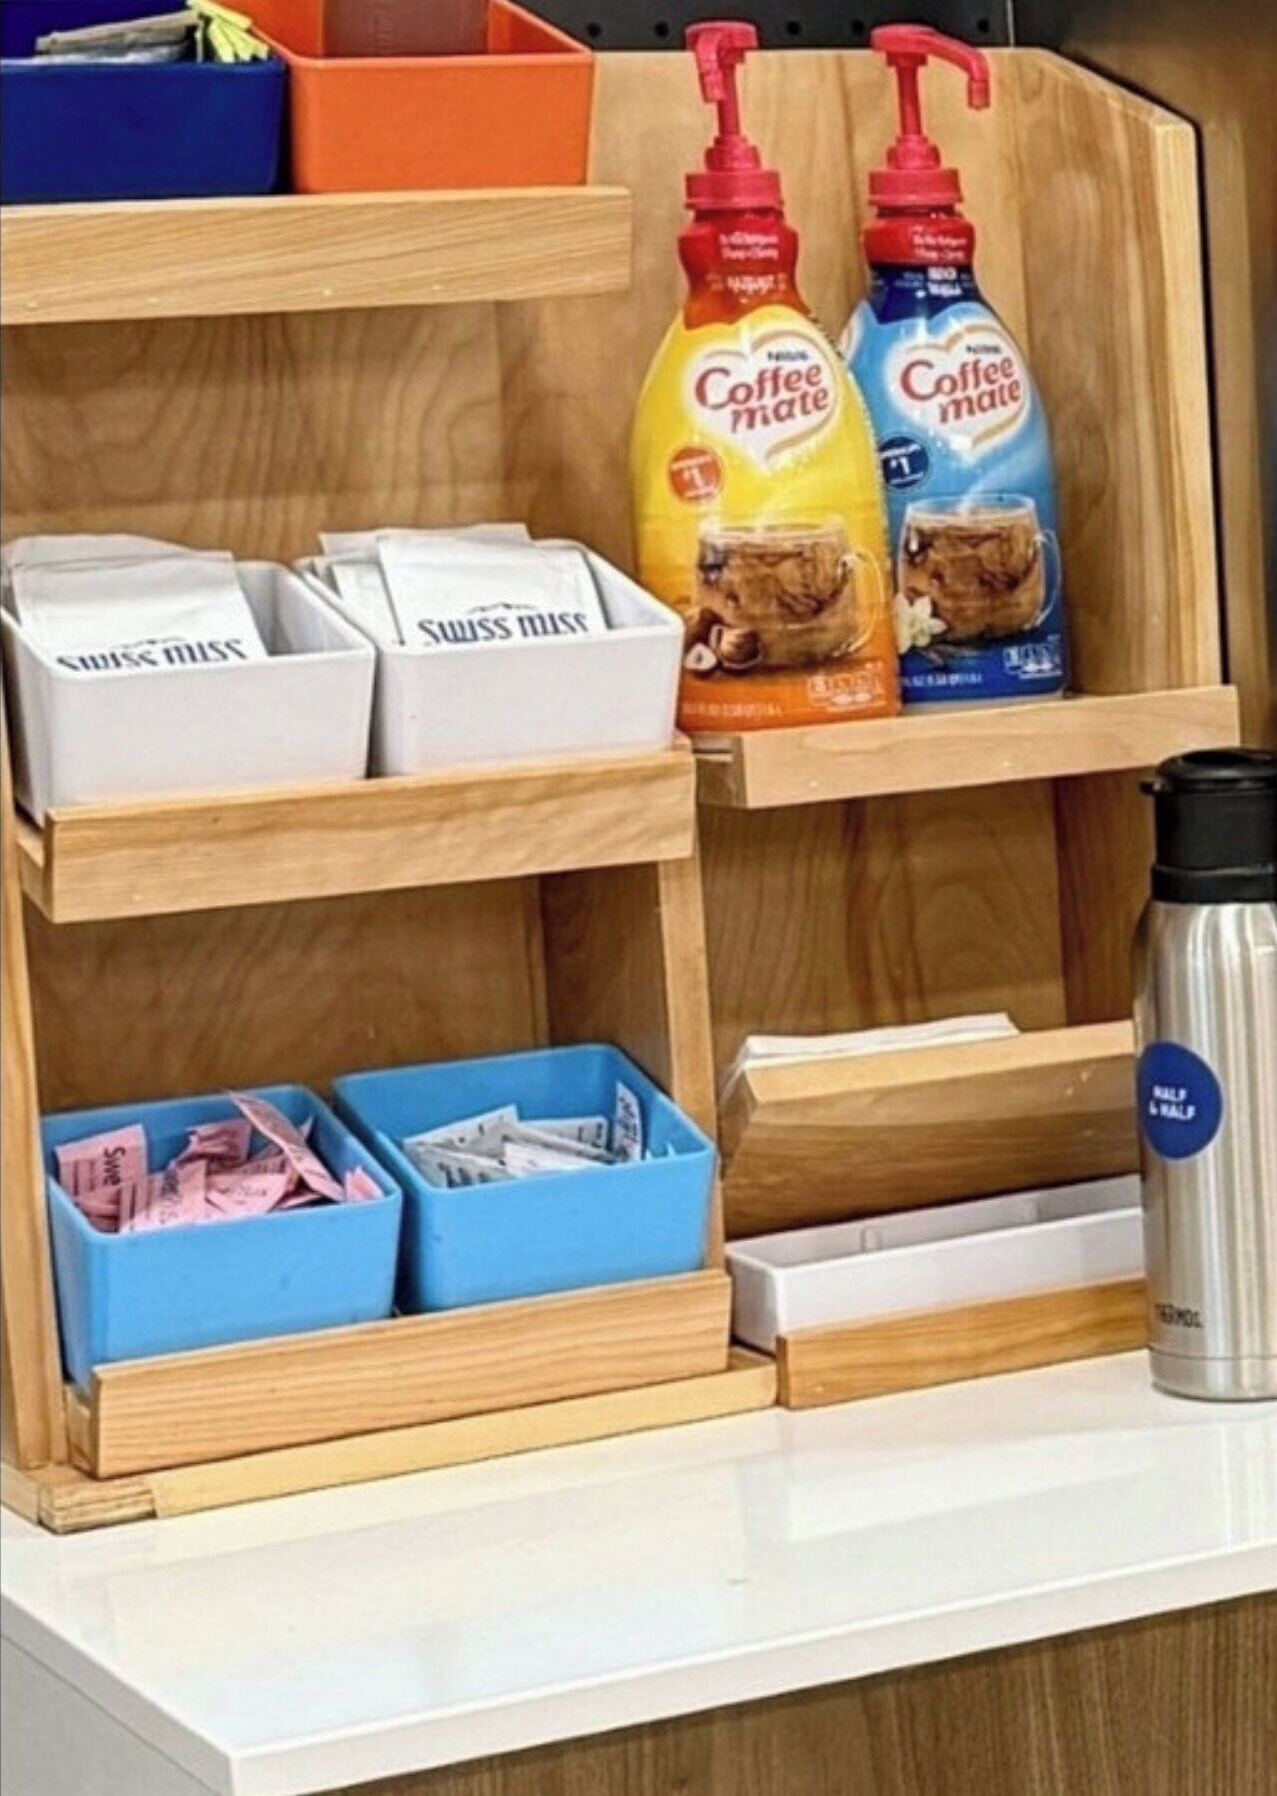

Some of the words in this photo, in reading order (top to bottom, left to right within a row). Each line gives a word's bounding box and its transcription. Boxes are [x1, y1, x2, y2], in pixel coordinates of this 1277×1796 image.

[695, 363, 823, 411] Coffee
[900, 356, 1014, 402] Coffee
[939, 379, 1021, 425] mate
[730, 387, 830, 435] mate
[1152, 1084, 1188, 1101] HALF
[1160, 1103, 1196, 1121] HALF
